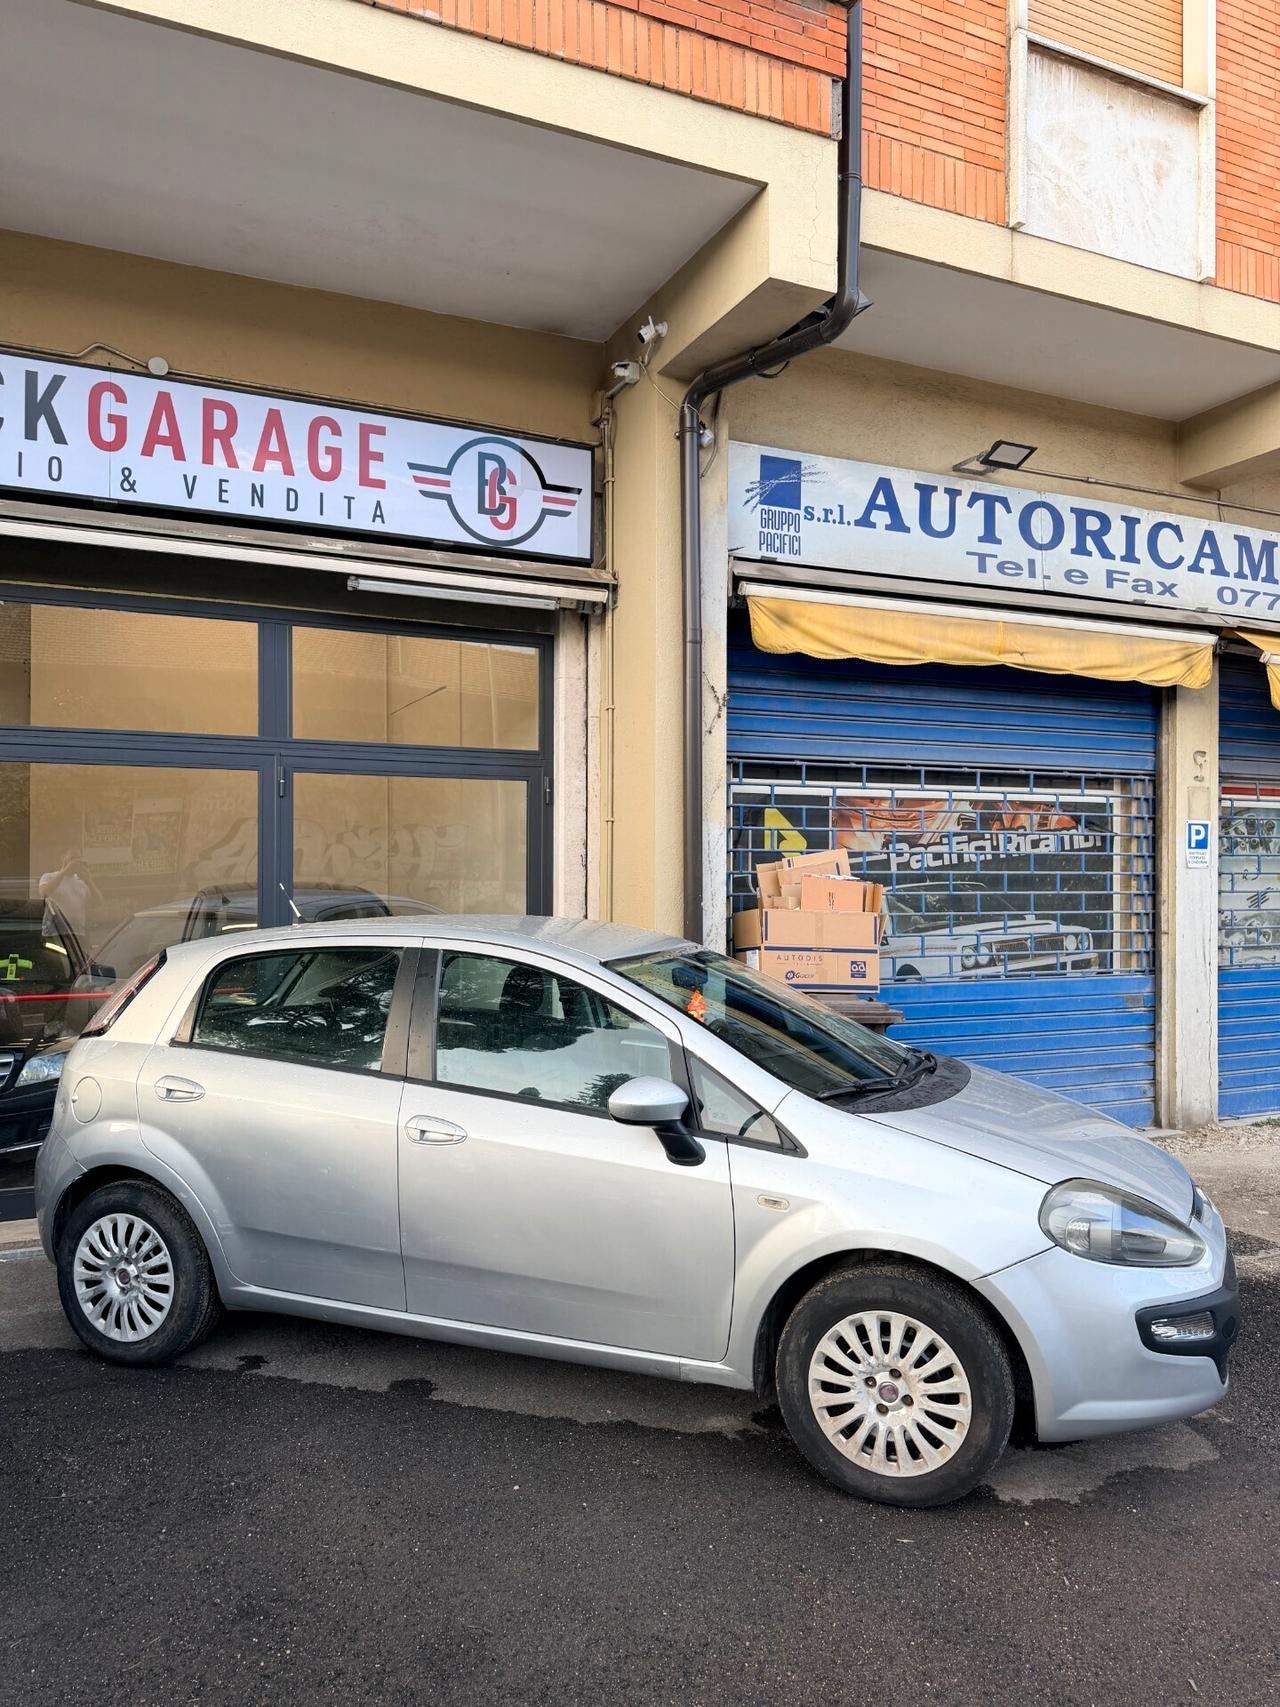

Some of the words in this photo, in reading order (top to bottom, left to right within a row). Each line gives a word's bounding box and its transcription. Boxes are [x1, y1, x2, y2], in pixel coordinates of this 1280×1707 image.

[0, 364, 68, 445] K
[88, 381, 386, 489] GARAGE
[120, 467, 137, 493] &
[183, 474, 386, 524] VENDITA
[760, 508, 800, 534] GRUPPO
[758, 531, 801, 556] PACIFICI
[804, 504, 851, 526] s.r.l.
[854, 477, 1279, 585] AUTORICAM
[966, 551, 1051, 580] Tel.
[1064, 569, 1089, 585] e
[1106, 569, 1179, 598] Fax
[1217, 586, 1280, 611] 077
[1191, 825, 1206, 848] P
